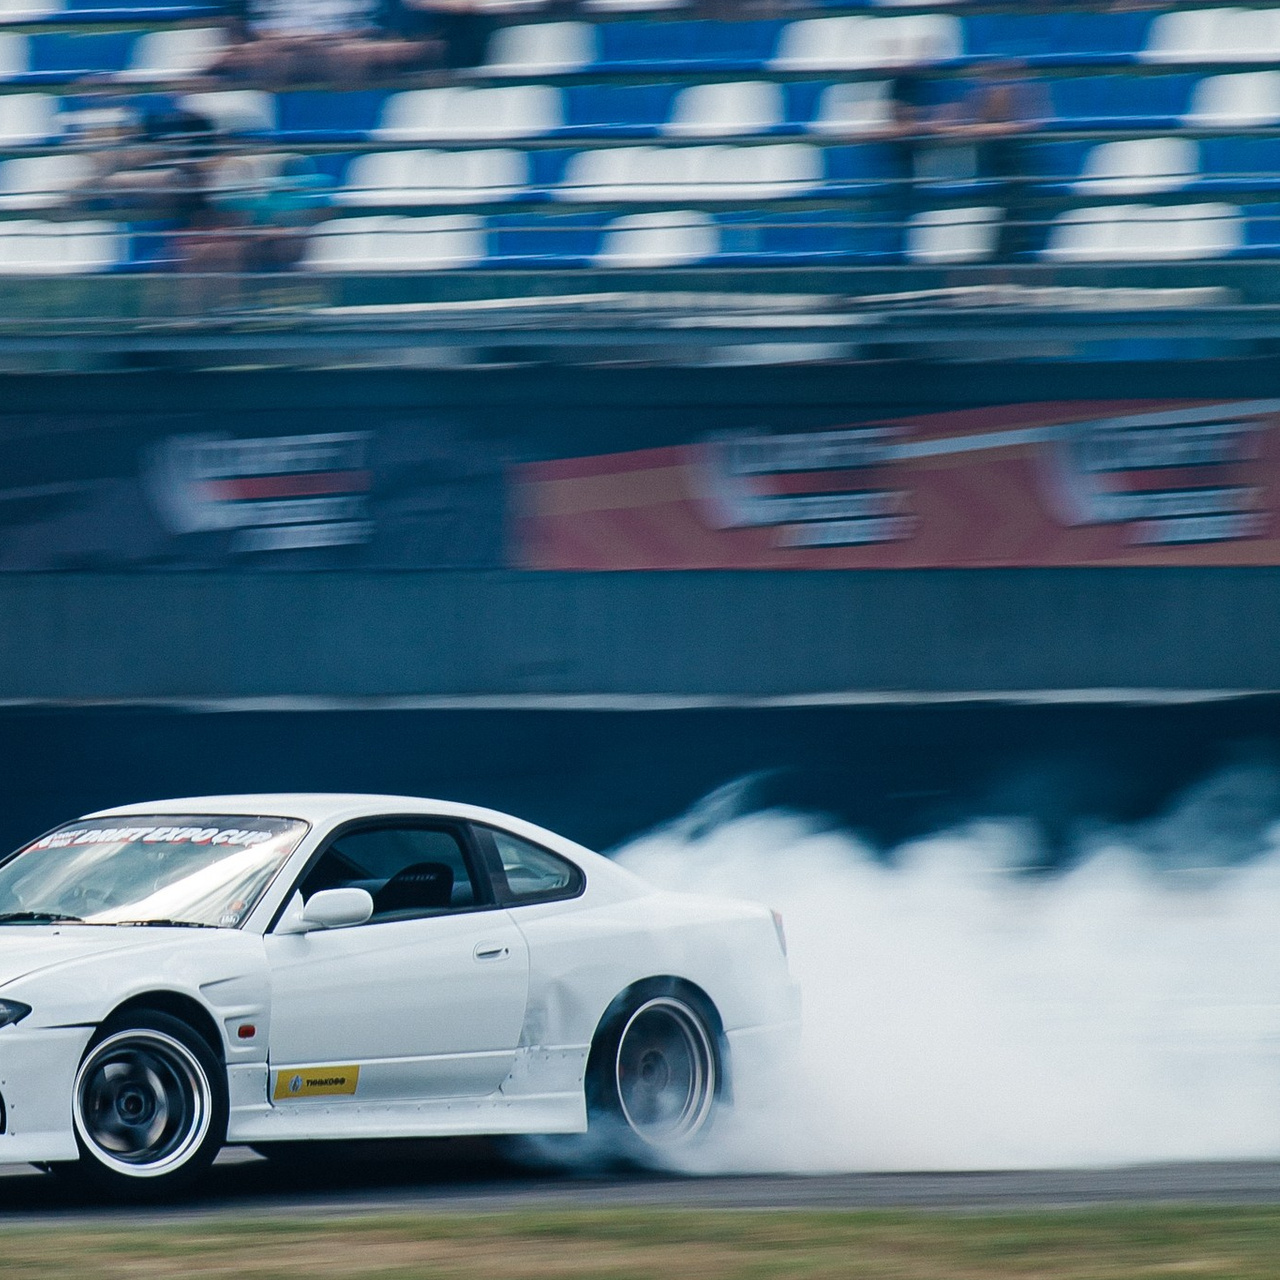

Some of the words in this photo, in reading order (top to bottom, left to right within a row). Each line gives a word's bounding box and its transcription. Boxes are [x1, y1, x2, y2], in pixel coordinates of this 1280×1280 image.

[73, 827, 157, 843] DRIFT
[142, 827, 219, 843] EXPO
[212, 829, 272, 847] CUP
